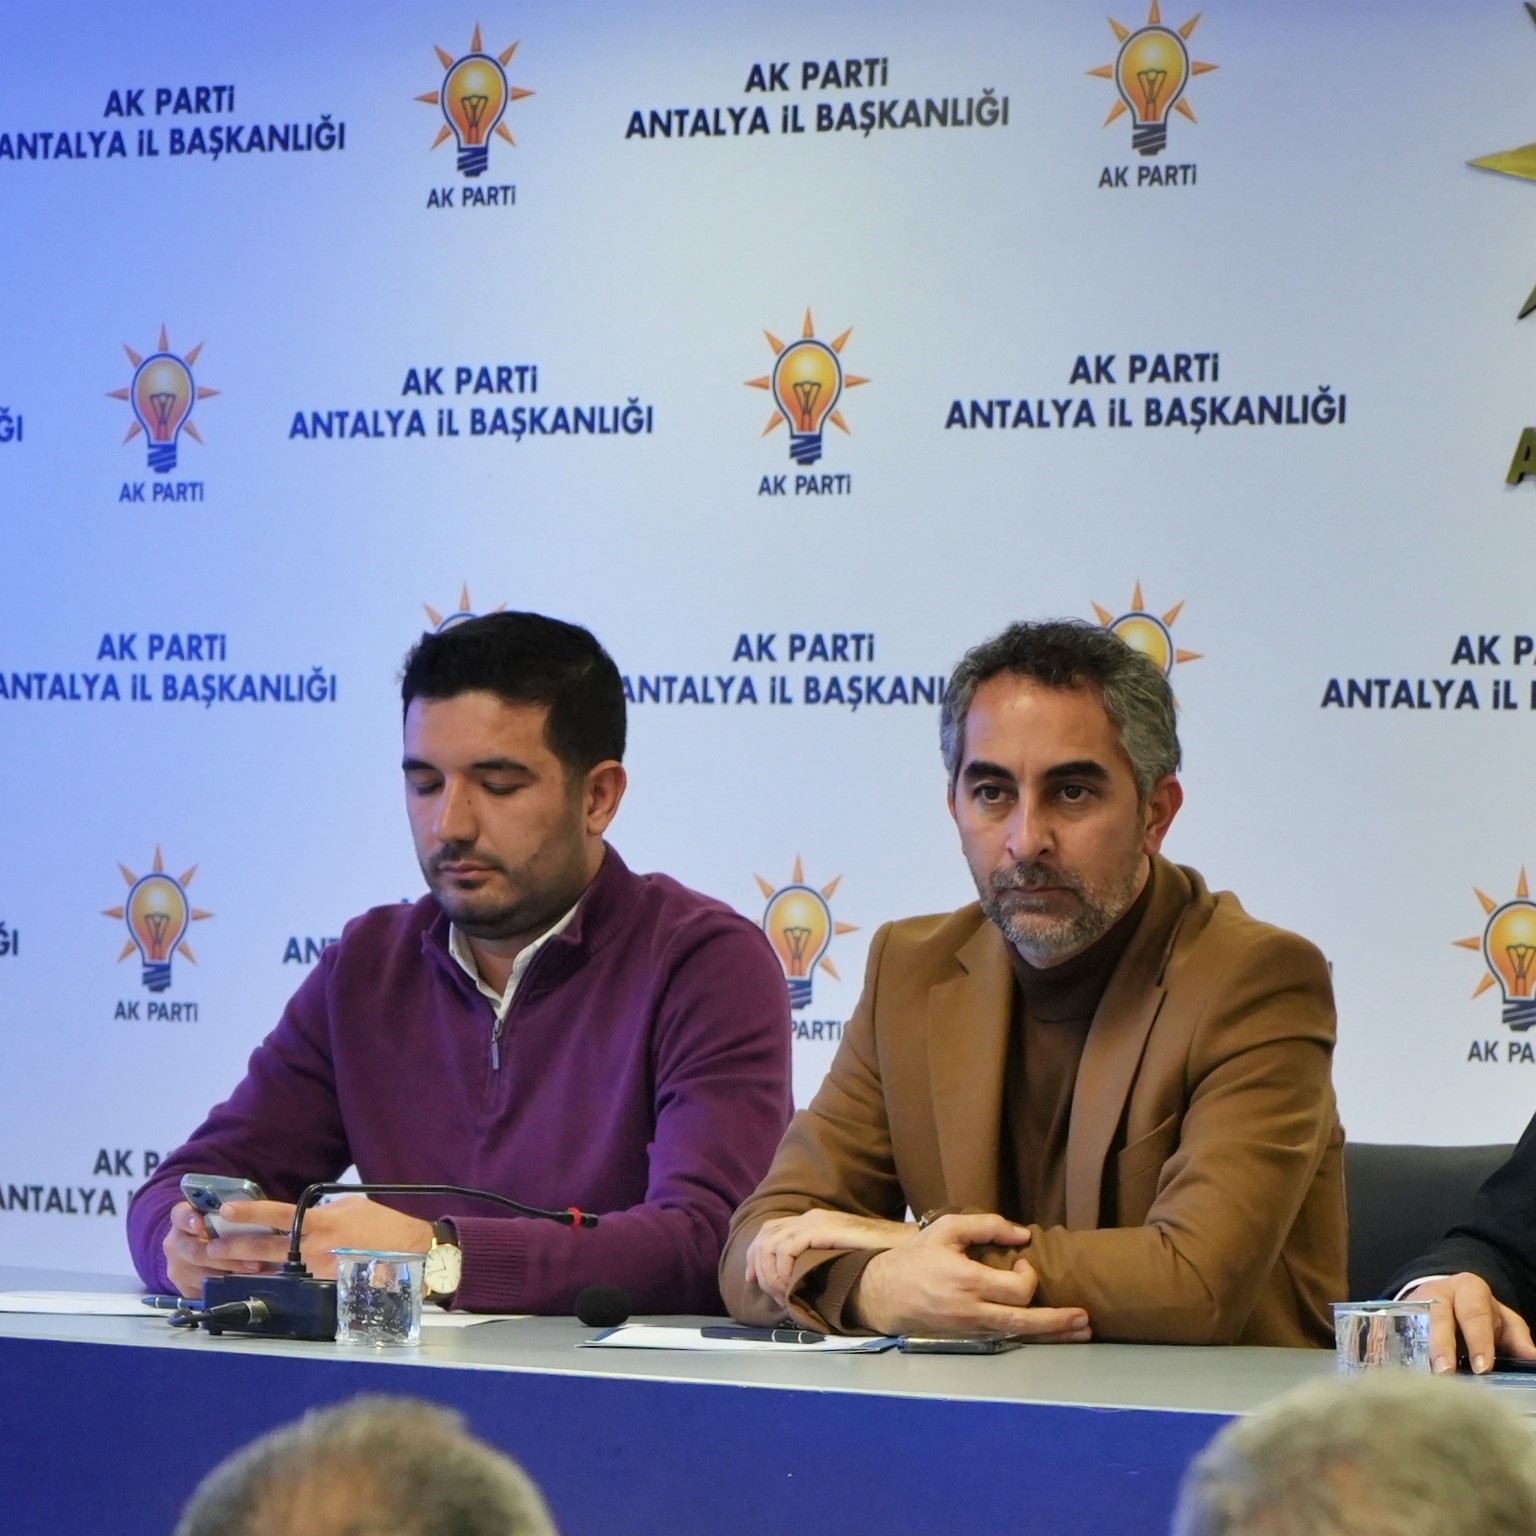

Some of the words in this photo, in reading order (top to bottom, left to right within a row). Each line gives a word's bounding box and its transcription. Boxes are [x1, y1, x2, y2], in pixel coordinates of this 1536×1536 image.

[745, 63, 789, 92] AK
[104, 89, 144, 117] AK
[626, 106, 769, 139] ANTALYA
[816, 87, 1010, 139] BAŞKANLIĞI
[170, 118, 344, 160] BAŞKANLIĞI
[1099, 167, 1128, 188] AK
[427, 188, 454, 208] AK
[402, 368, 443, 395] AK
[1069, 355, 1115, 384] AK
[289, 410, 425, 439] ANTALYA
[470, 398, 652, 442] BAŞKANLIĞI
[946, 399, 1096, 429] ANTALYA
[1145, 386, 1346, 434] BAŞKANLIĞI
[119, 483, 144, 502] AK
[759, 475, 786, 495] AK
[97, 634, 137, 660] AK
[733, 634, 776, 662] AK
[1451, 636, 1500, 665] AK
[162, 666, 337, 709] BAŞKANLIĞI
[1321, 679, 1479, 709] ANTALYA
[115, 1001, 139, 1020] AK
[1468, 1041, 1498, 1062] AK
[94, 1149, 132, 1176] AK
